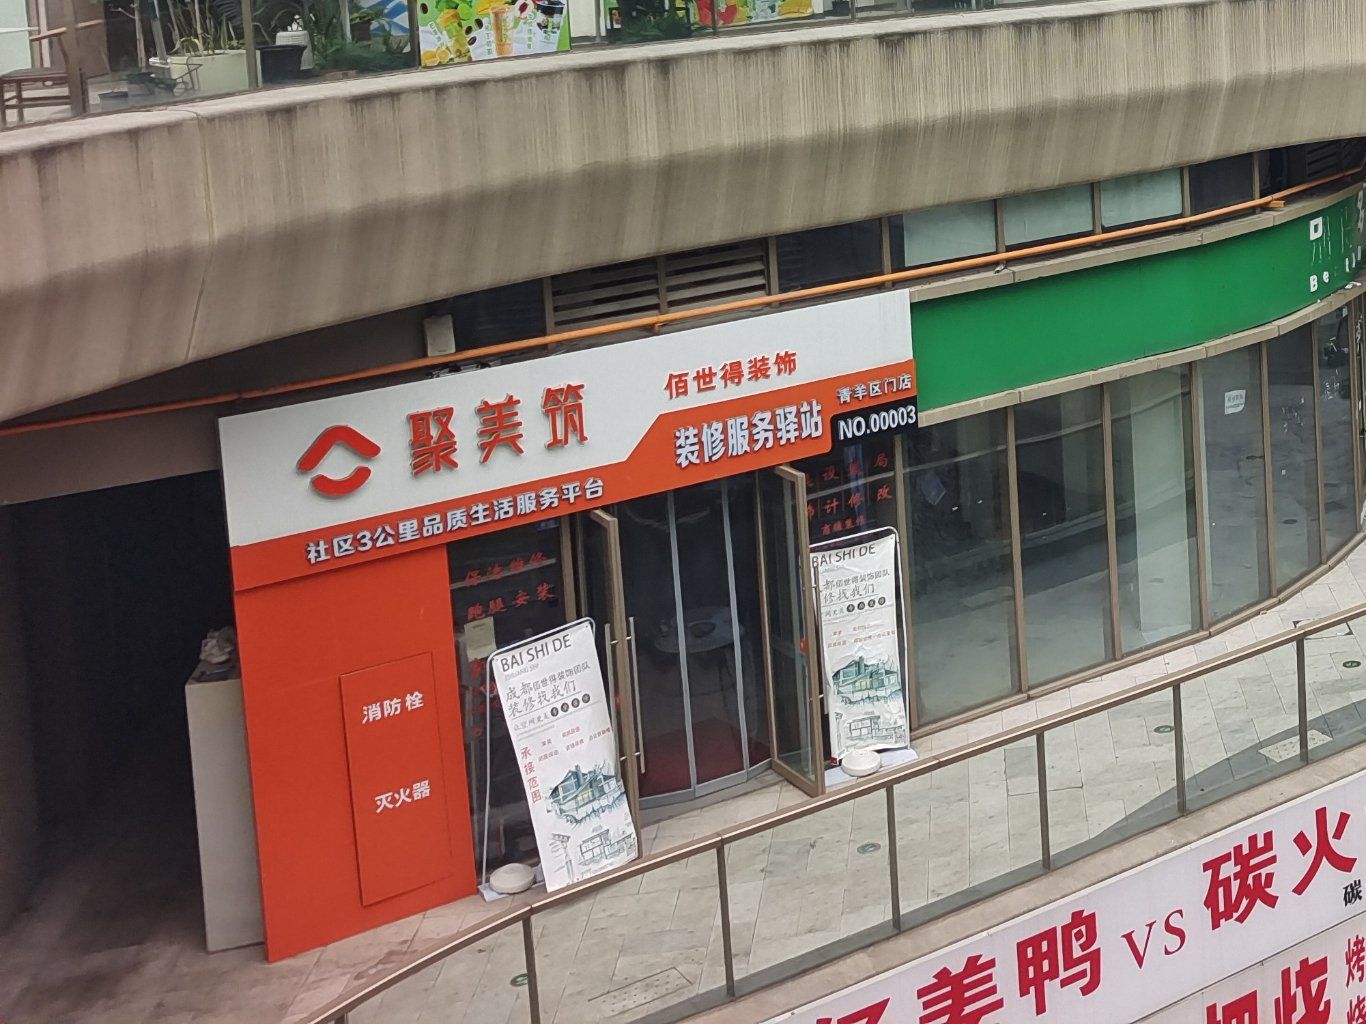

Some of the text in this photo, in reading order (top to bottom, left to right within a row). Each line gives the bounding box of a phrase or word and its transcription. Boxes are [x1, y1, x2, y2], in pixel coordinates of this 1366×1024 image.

[664, 350, 798, 400] 佰世得装饰
[836, 373, 913, 405] 青羊区门店
[408, 382, 590, 478] 聚美筑
[674, 398, 823, 470] 装修服务驿站
[838, 406, 918, 441] NO.00003
[306, 477, 604, 565] 社区3公里品质生活服务平台
[811, 542, 876, 569] BAI SHI DE
[500, 633, 572, 672] BAI SHI DE
[362, 691, 424, 724] 消防栓
[374, 779, 431, 814] 灭火器
[816, 909, 1102, 1024] 姜鸭
[1120, 908, 1188, 971] VS
